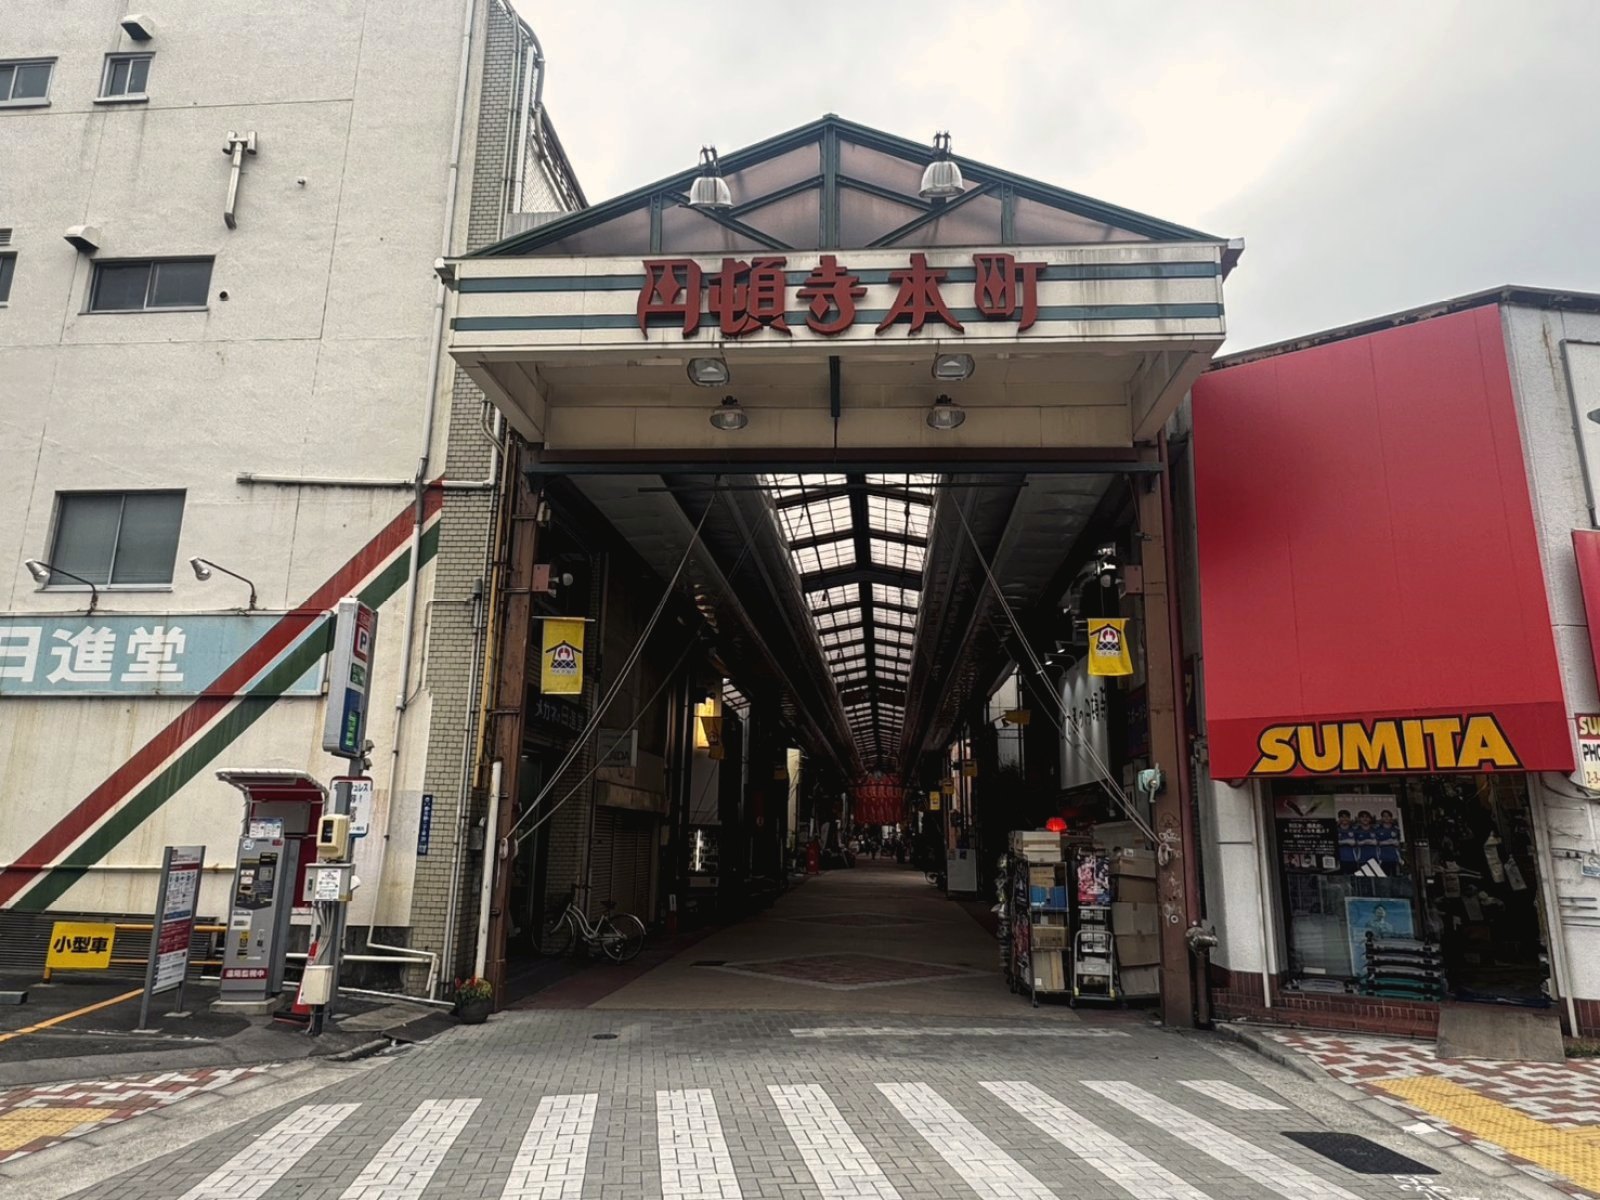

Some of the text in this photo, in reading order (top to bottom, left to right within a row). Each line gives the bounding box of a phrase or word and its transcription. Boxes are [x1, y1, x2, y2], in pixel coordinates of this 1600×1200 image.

[637, 253, 1047, 340] 円頓寺本町
[0, 626, 187, 684] 日進堂
[359, 631, 368, 649] P
[1248, 714, 1523, 775] SUMITA
[1579, 716, 1600, 735] SU
[53, 936, 109, 954] 小型車
